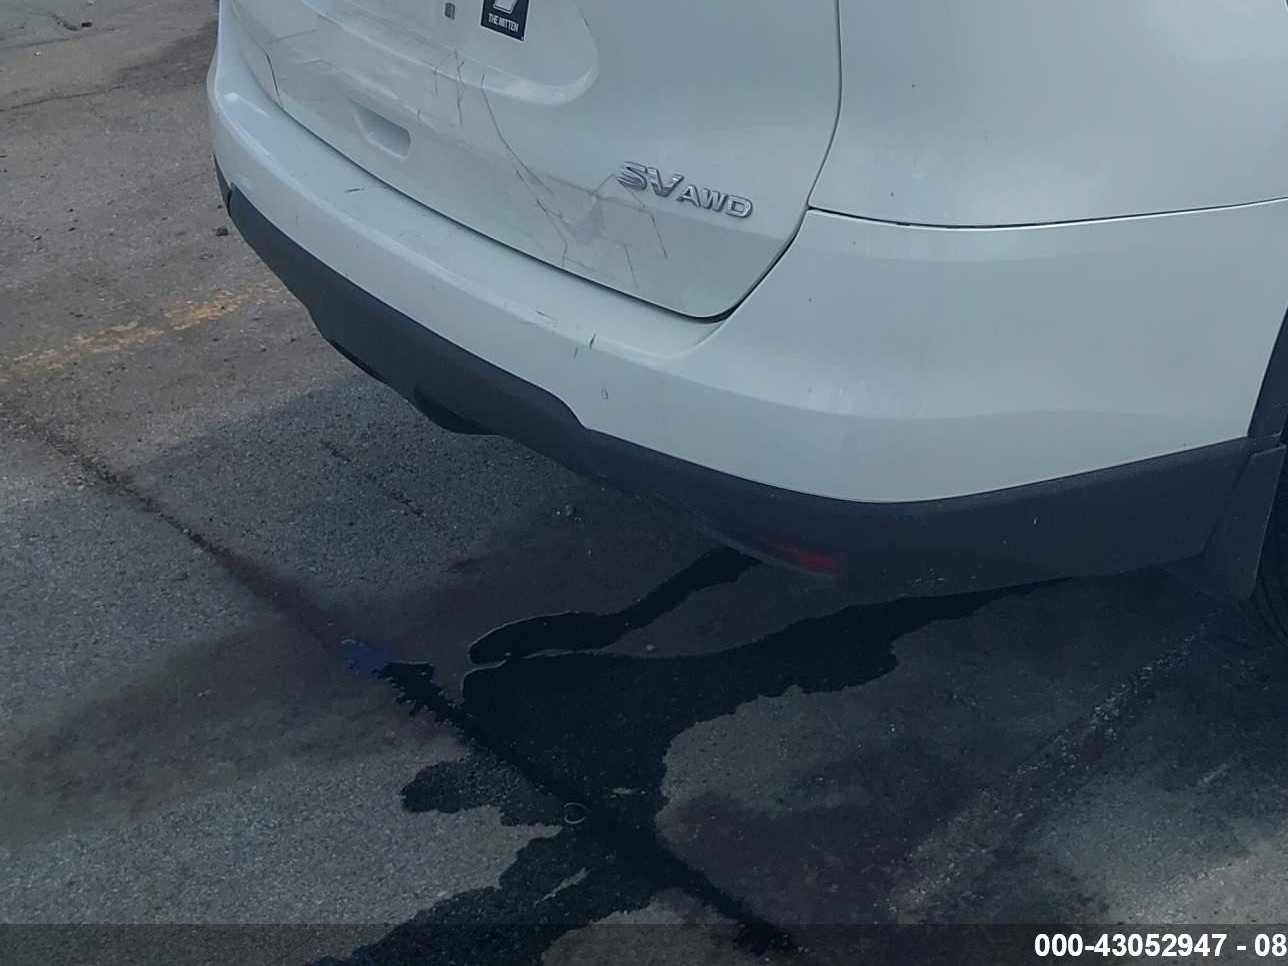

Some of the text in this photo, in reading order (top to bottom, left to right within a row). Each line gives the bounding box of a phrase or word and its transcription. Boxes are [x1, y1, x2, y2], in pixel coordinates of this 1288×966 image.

[488, 13, 499, 25] THE
[617, 161, 753, 219] SV AWD
